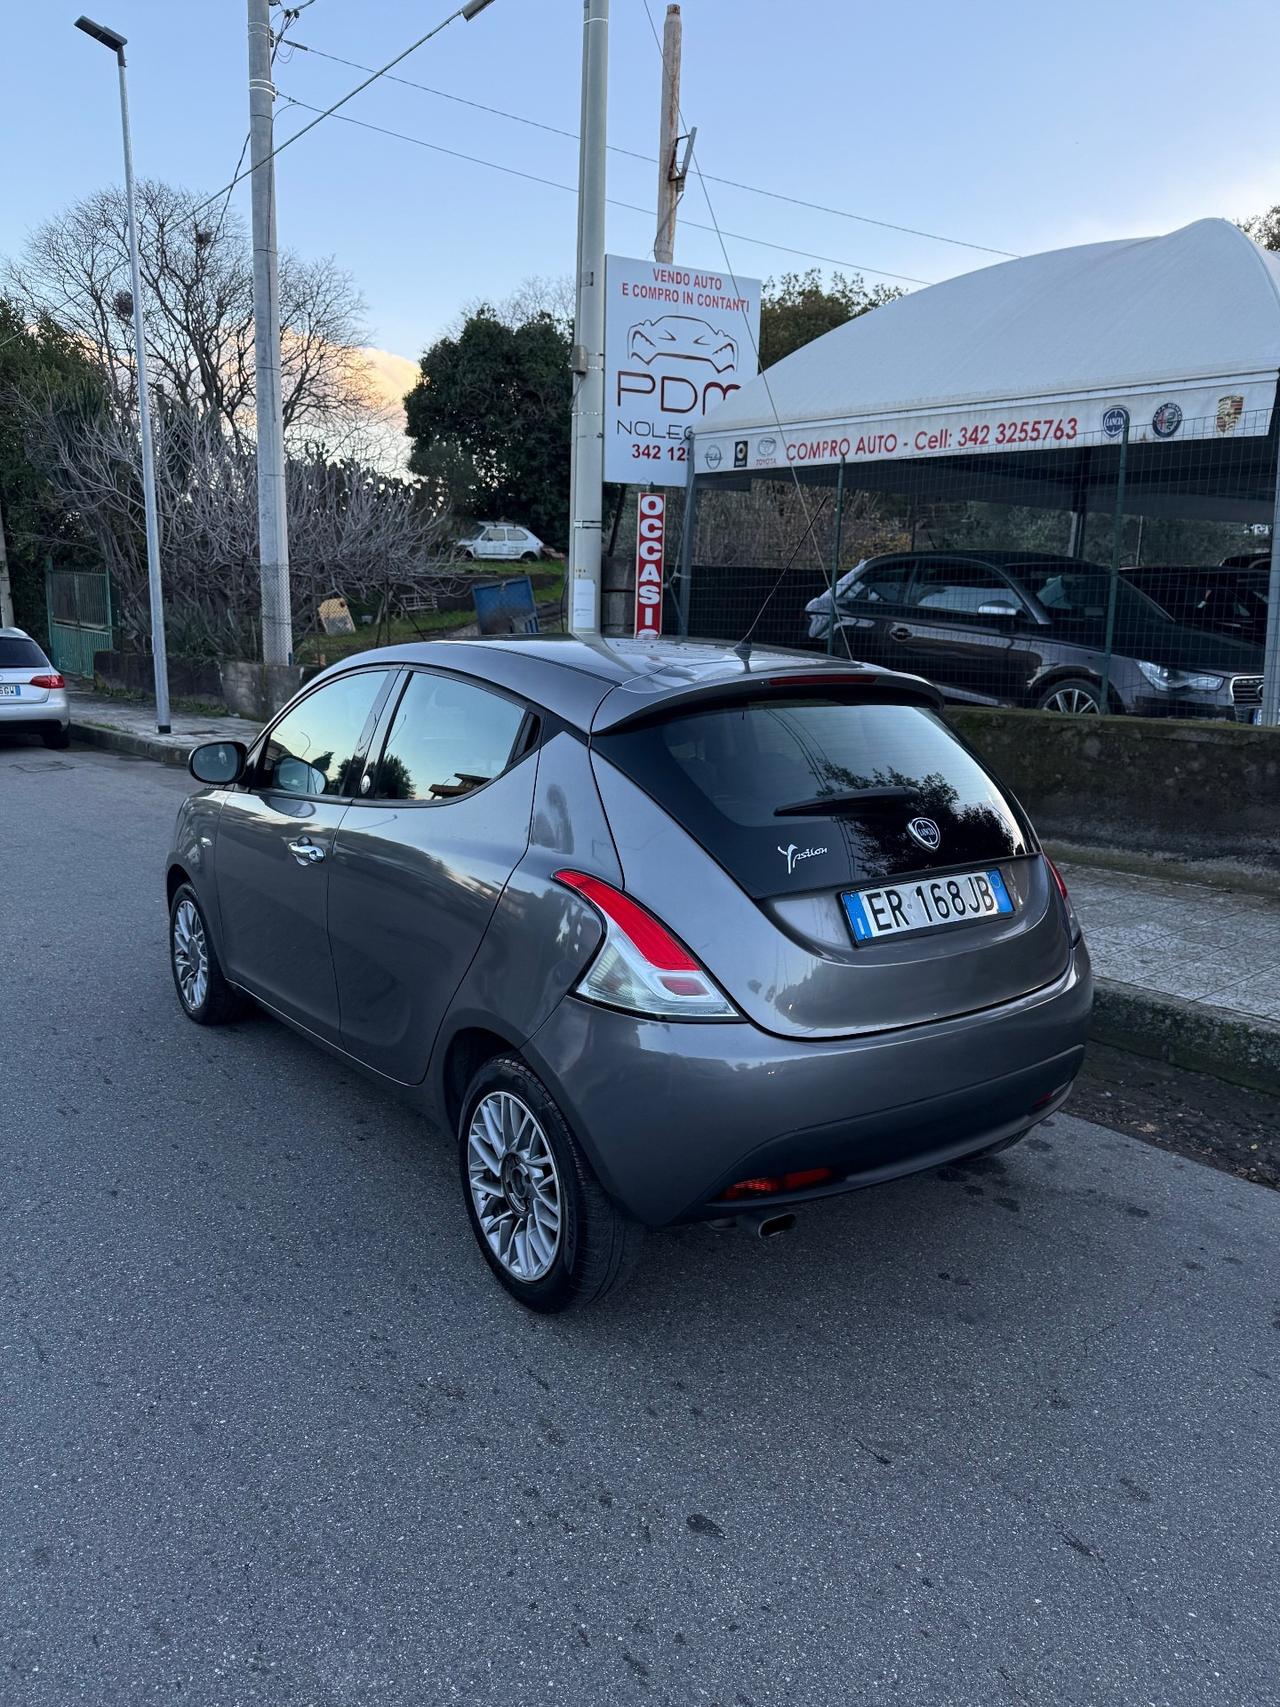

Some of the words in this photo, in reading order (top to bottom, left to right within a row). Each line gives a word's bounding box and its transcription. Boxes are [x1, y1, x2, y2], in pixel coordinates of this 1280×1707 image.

[653, 268, 690, 286] VENDO
[694, 275, 722, 290] AUTO
[622, 282, 629, 296] E
[632, 284, 679, 303] COMPRO
[683, 291, 694, 305] IN
[697, 293, 750, 312] CONTANTI
[631, 444, 661, 460] 342
[667, 447, 689, 461] 12
[786, 438, 850, 461] COMPRO
[855, 433, 897, 455] AUTO
[915, 429, 952, 450] Cell:
[958, 425, 990, 447] 342
[995, 417, 1078, 445] 3255763
[777, 843, 828, 875] Ypsilon
[866, 889, 910, 932] ER
[915, 876, 995, 923] 168JB
